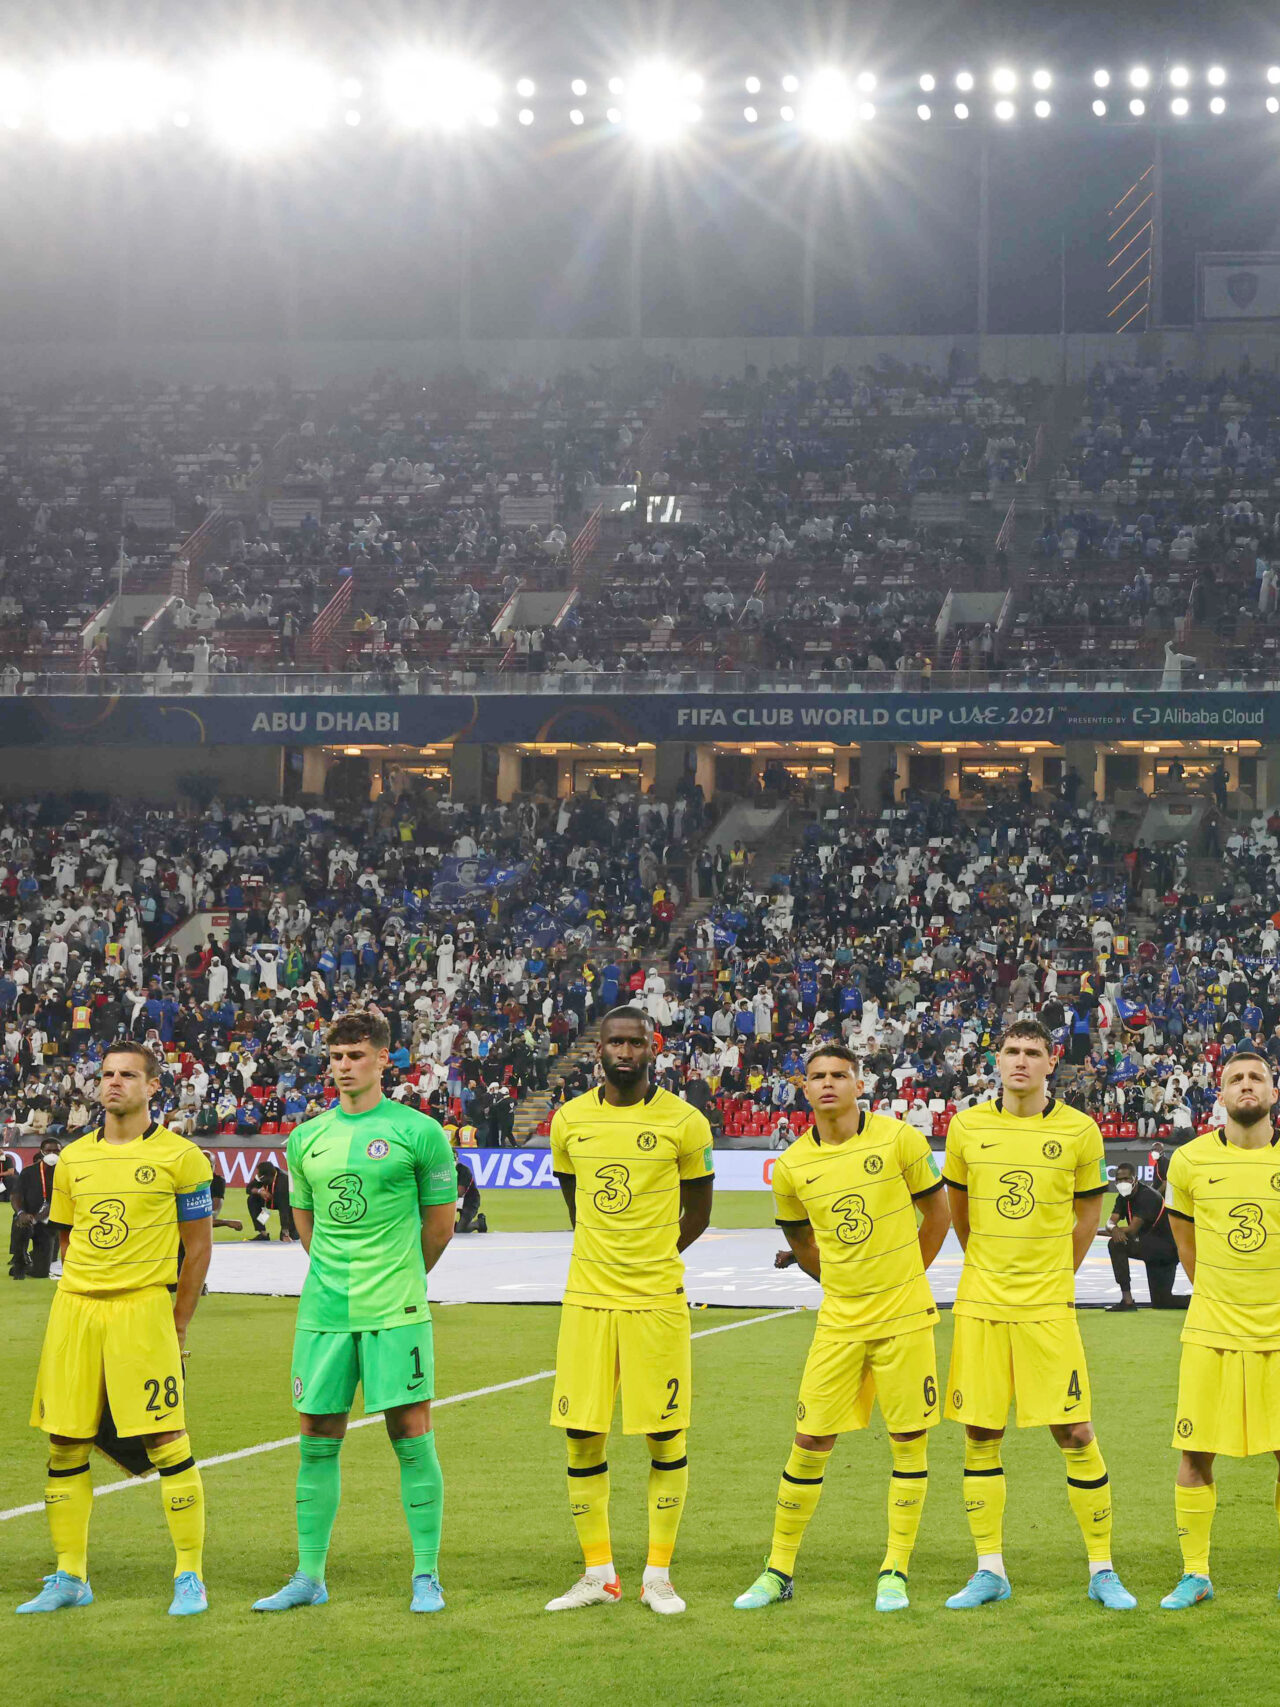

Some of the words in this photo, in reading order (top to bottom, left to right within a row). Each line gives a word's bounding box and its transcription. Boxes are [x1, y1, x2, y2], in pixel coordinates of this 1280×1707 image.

[251, 711, 307, 732] ABU
[316, 711, 399, 732] DHABI
[677, 708, 727, 726] FIFA
[732, 708, 794, 726] CLUB
[800, 708, 889, 726] WORLD
[895, 708, 943, 726] CUP
[949, 706, 1004, 725] UAE
[1004, 706, 1055, 725] 2021
[1163, 707, 1219, 725] Alibaba
[1222, 707, 1264, 725] Cloud
[462, 1153, 560, 1187] VISA
[328, 1173, 367, 1224] 3
[593, 1164, 632, 1214] 3
[996, 1170, 1035, 1220] 3
[88, 1199, 129, 1249] 3
[831, 1194, 873, 1245] 3
[1228, 1202, 1267, 1252] 3
[410, 1346, 424, 1379] 1
[144, 1376, 179, 1411] 28
[667, 1378, 680, 1411] 2
[923, 1375, 937, 1407] 6
[1067, 1370, 1081, 1401] 4
[171, 1495, 196, 1504] CFC
